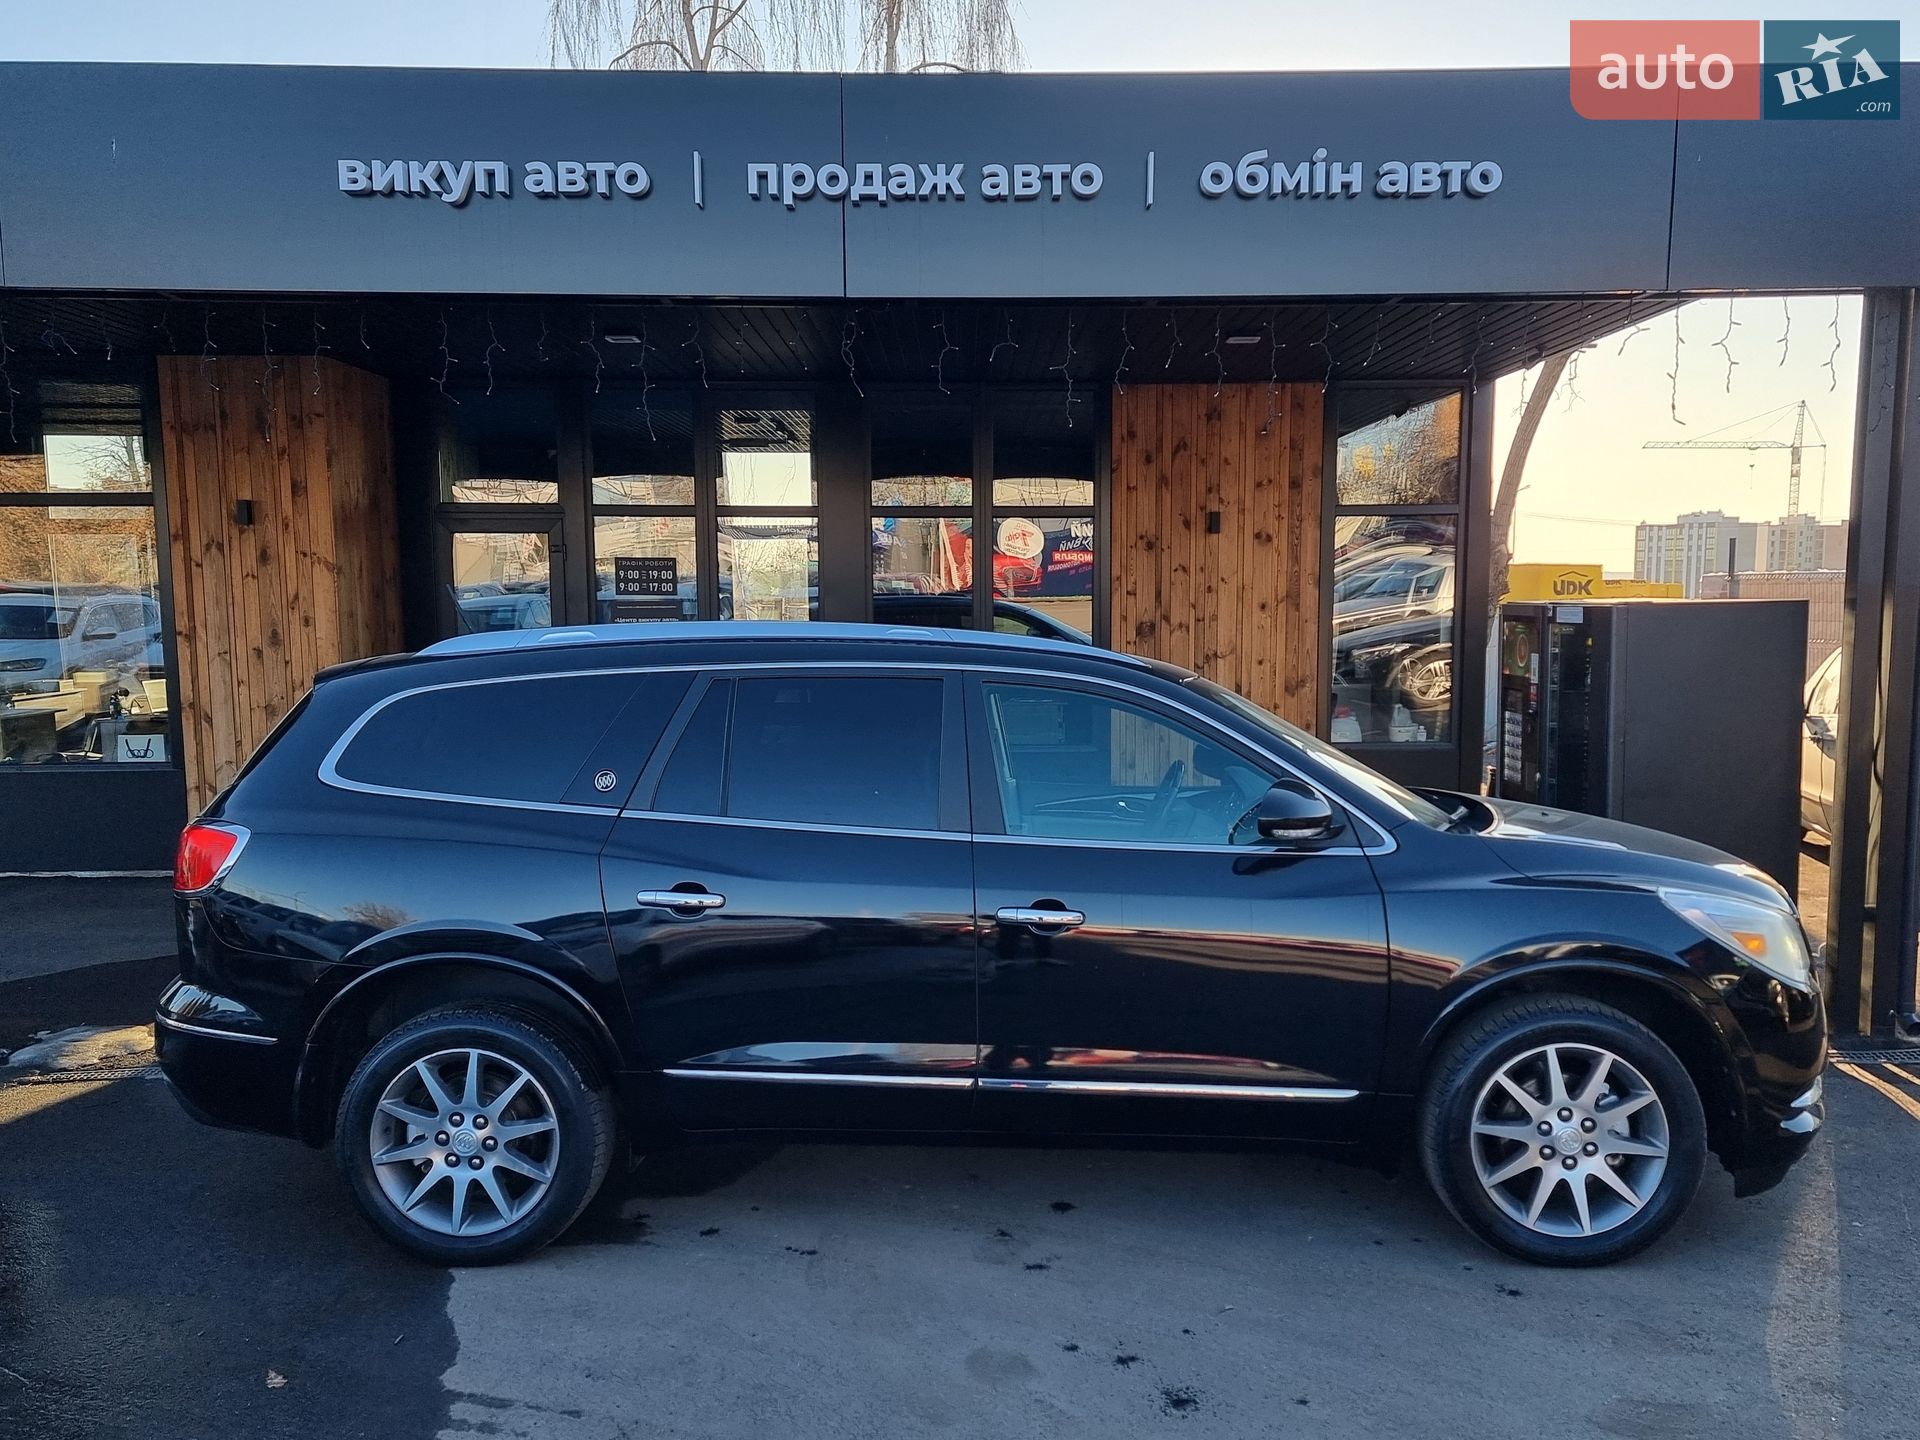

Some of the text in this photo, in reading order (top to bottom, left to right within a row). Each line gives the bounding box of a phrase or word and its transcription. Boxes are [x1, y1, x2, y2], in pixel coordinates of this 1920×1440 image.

[337, 147, 1504, 208] викуп авто продаж авто обмін авто
[619, 570, 640, 579] 9:00
[648, 570, 673, 579] 19:00
[619, 583, 640, 591] 9:00
[649, 583, 673, 591] 17:00
[1553, 578, 1594, 596] UDK
